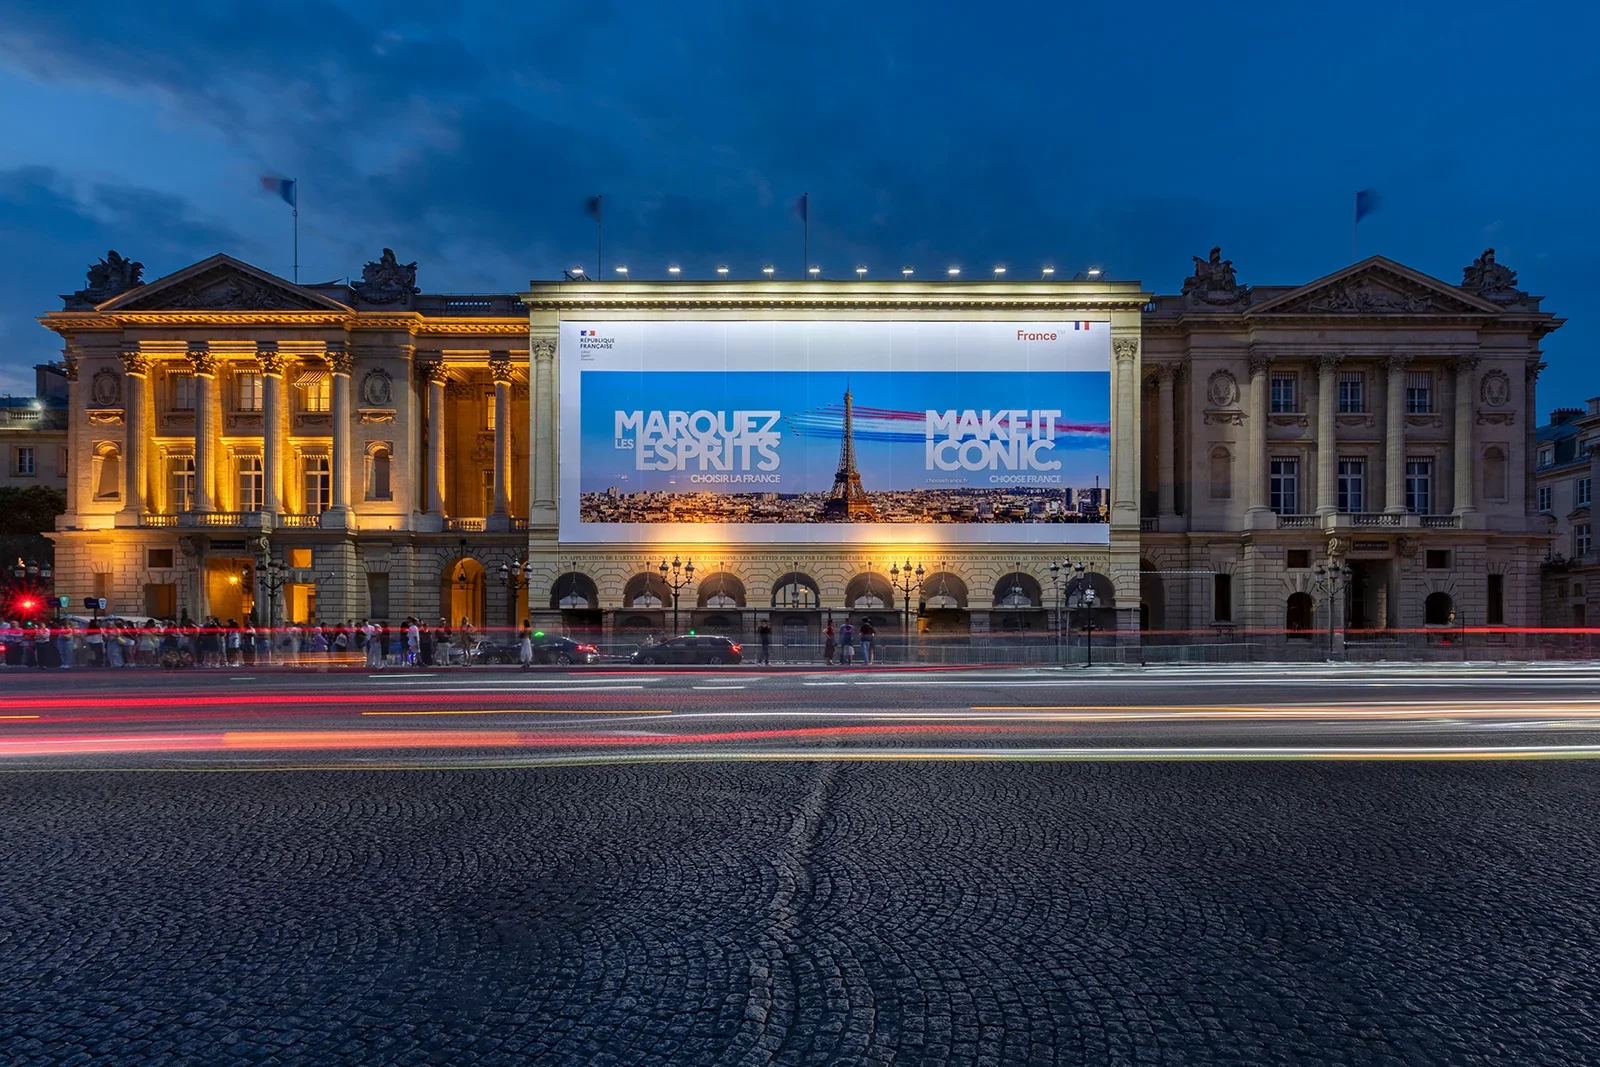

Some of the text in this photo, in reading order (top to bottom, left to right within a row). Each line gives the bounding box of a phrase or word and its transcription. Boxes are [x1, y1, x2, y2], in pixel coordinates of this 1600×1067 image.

[1017, 329, 1057, 341] France
[614, 409, 782, 445] MARQUEZ
[925, 409, 1062, 441] MAKE IT
[614, 437, 781, 472] LES ESPRITS
[925, 439, 1063, 471] ICONIC.
[690, 474, 781, 484] CHOISIR LA FRANCE
[989, 475, 1062, 484] CHOOSE FRANCE
